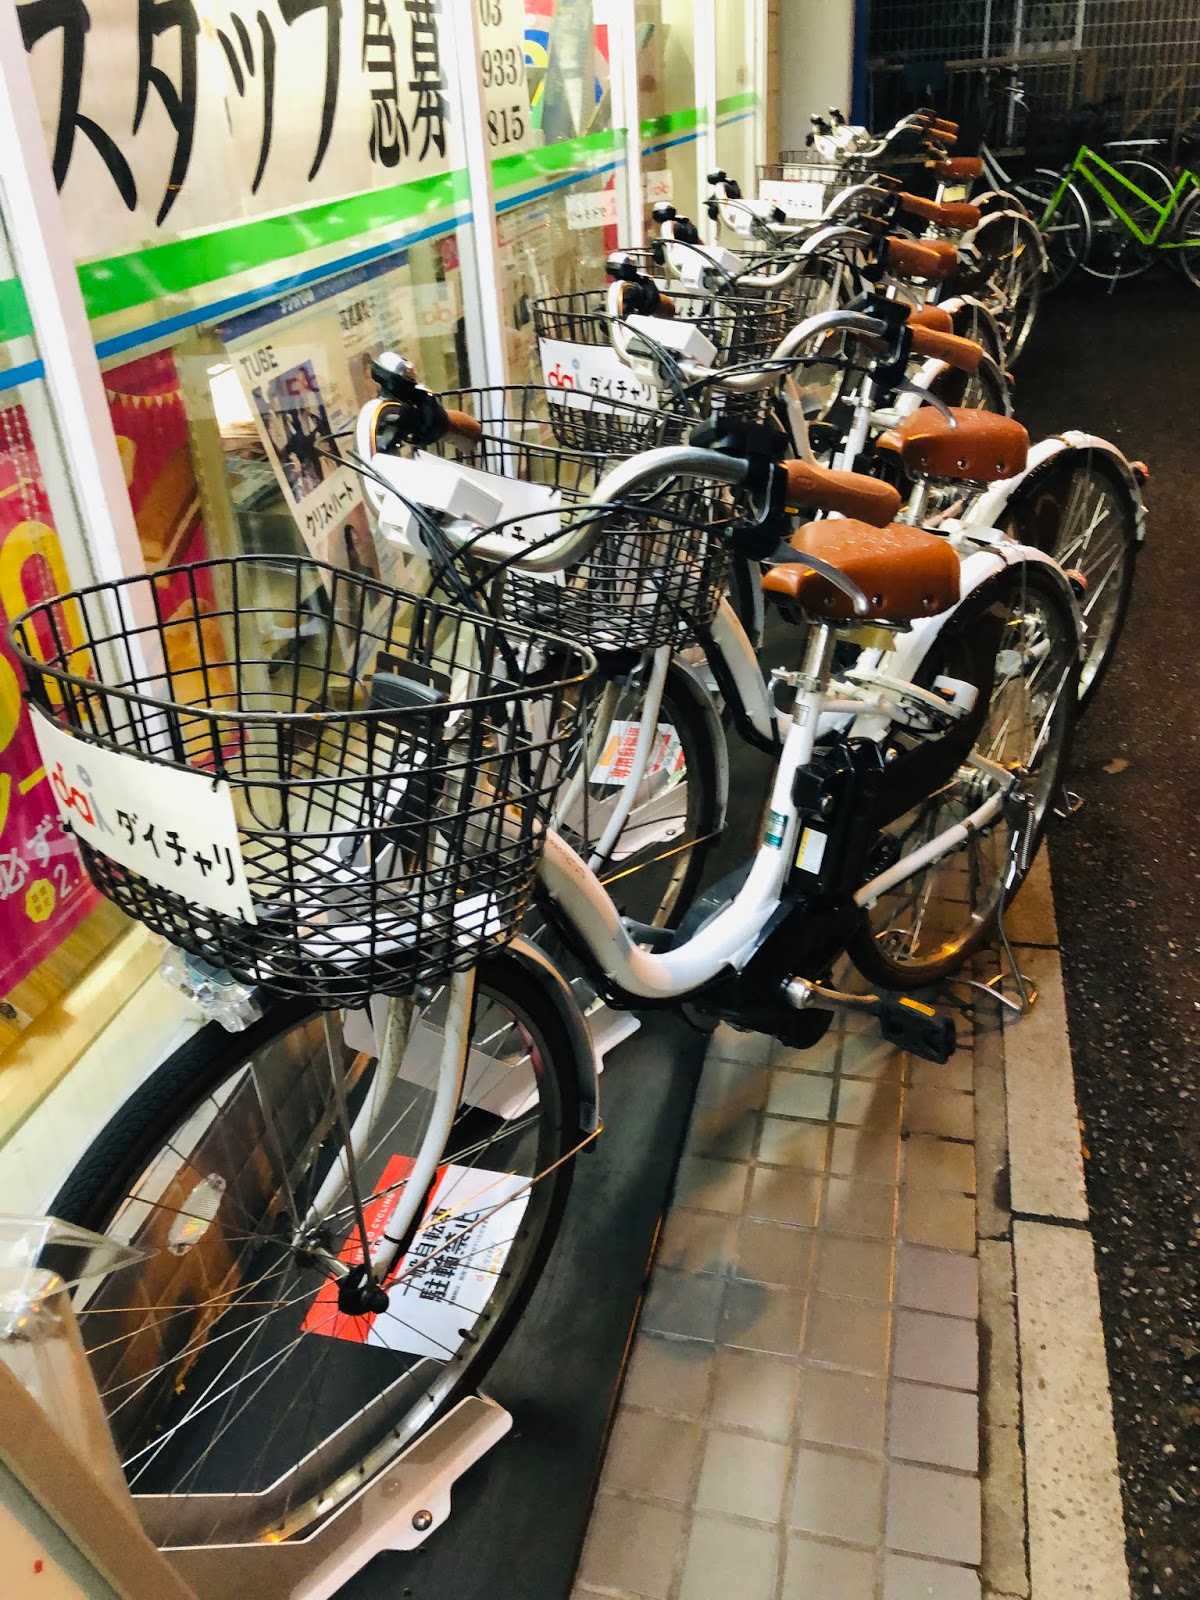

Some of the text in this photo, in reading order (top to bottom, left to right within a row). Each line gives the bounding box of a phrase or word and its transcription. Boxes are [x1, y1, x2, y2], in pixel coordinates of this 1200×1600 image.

[17, 0, 450, 227] スタッフ急募
[239, 345, 279, 381] TUBE
[115, 808, 236, 887] ダイチャリ
[372, 1193, 396, 1229] CYCLING
[419, 1212, 482, 1304] 駐輪禁止
